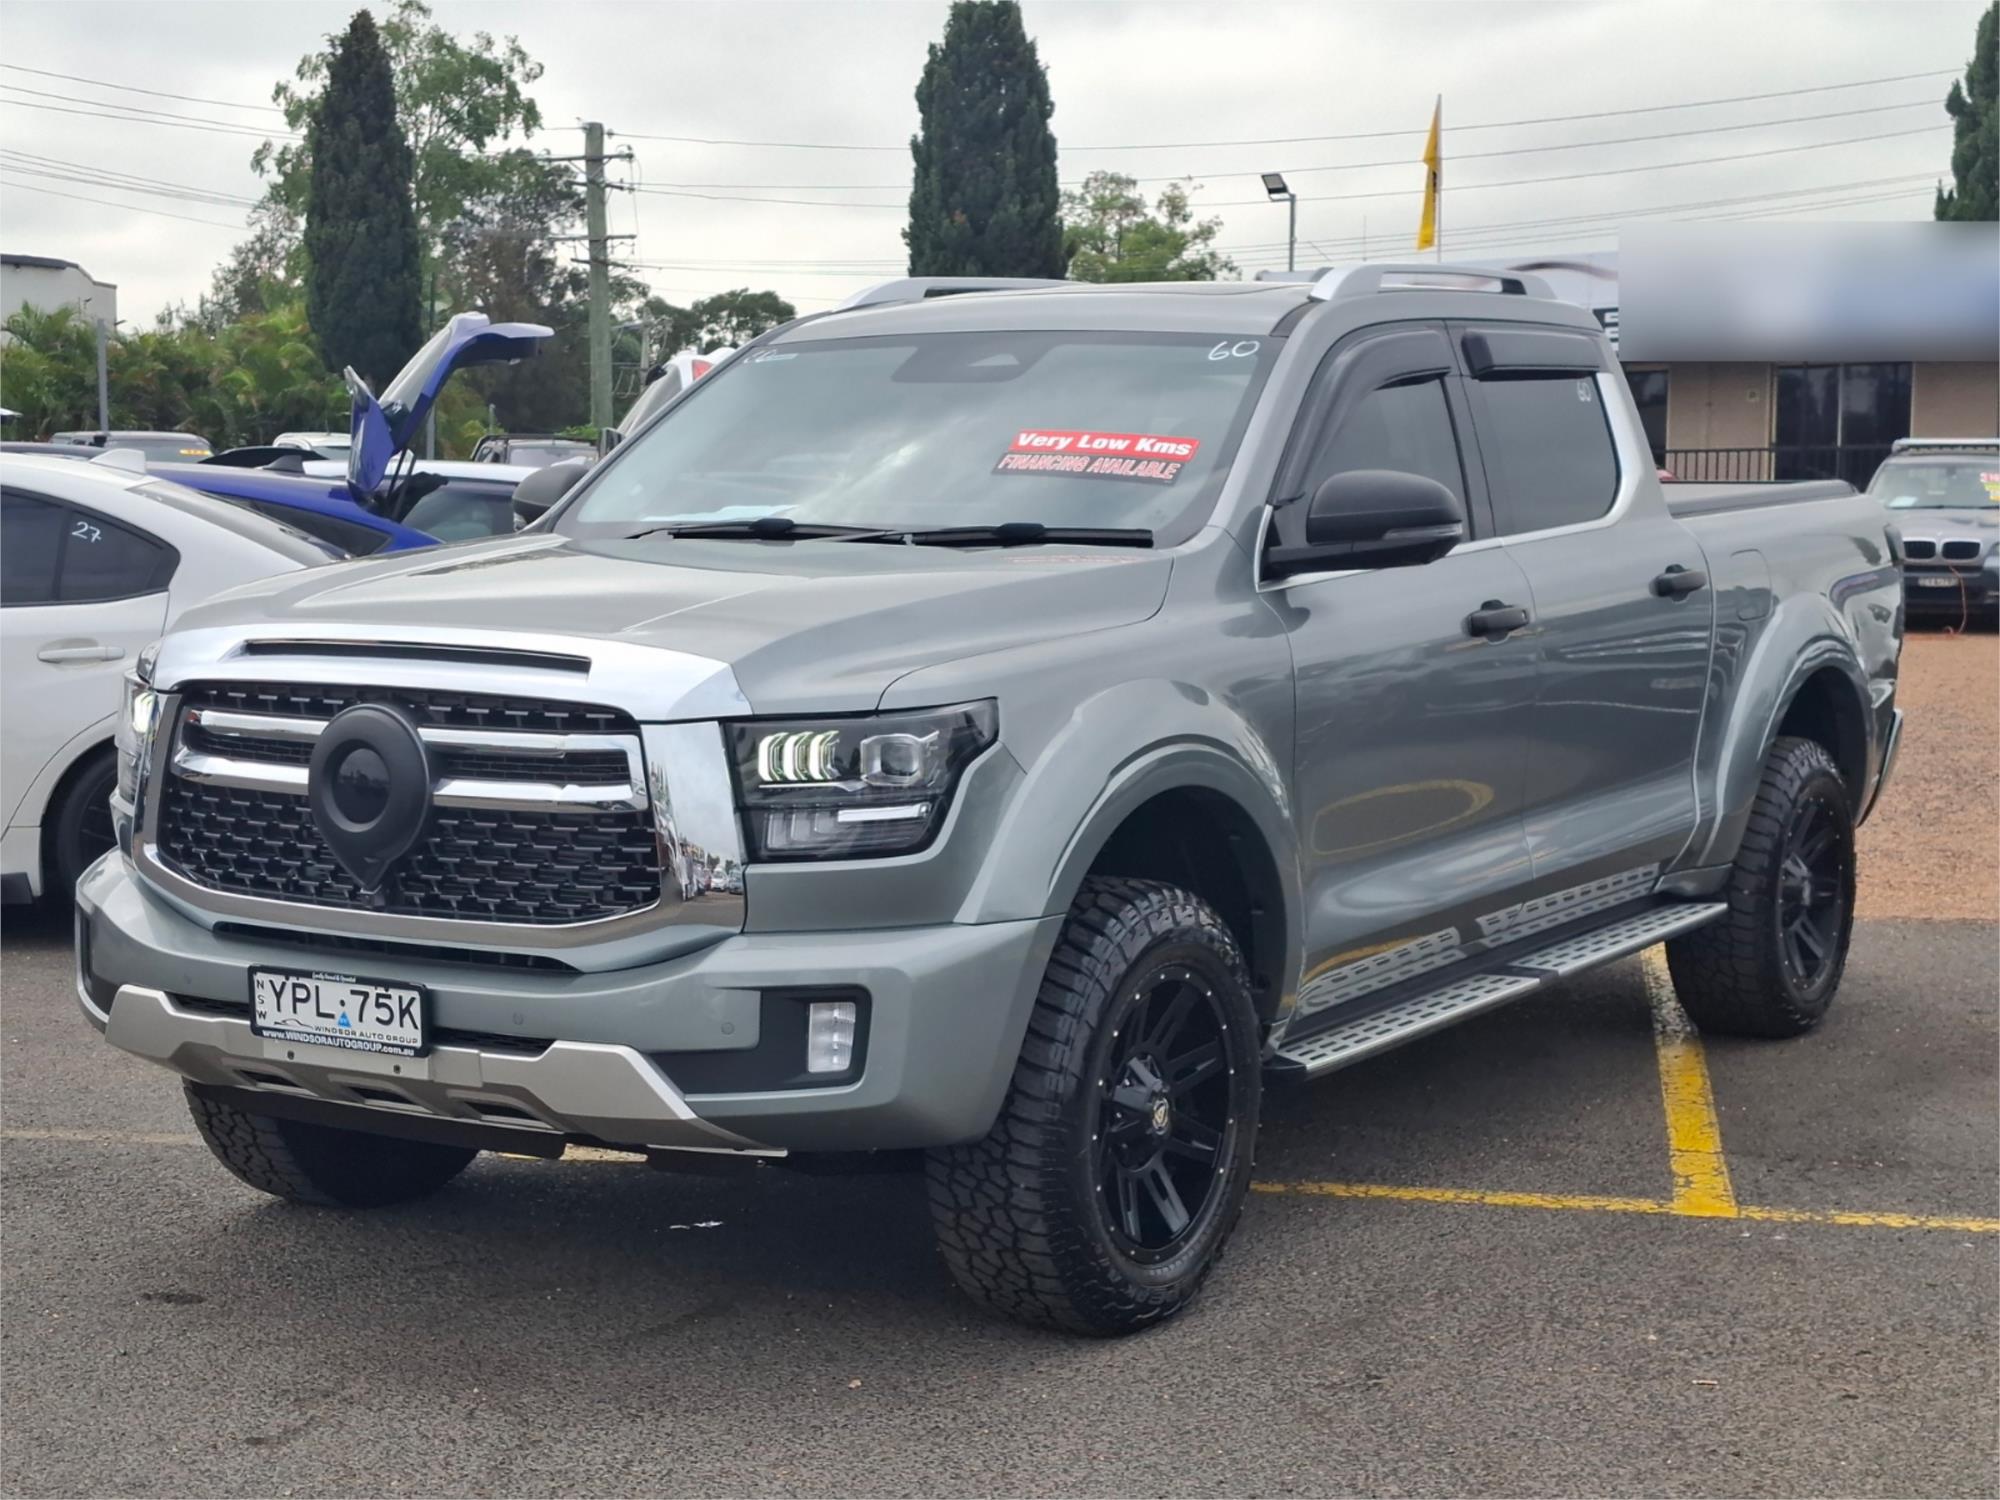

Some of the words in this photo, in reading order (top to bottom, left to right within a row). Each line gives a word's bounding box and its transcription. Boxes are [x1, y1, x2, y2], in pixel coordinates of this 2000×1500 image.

[1208, 340, 1261, 361] 60
[1017, 433, 1074, 450] Very
[1078, 434, 1131, 450] Low
[1135, 437, 1193, 456] Kms
[997, 454, 1090, 473] FINANCING
[1087, 456, 1182, 480] AVAILABLE
[71, 521, 102, 543] 27
[261, 1029, 415, 1057] www.WINDSORAUTOGROUP.com.au
[314, 1025, 357, 1037] WINDSOR
[358, 1031, 384, 1041] AUTO
[385, 1034, 418, 1045] GROUP
